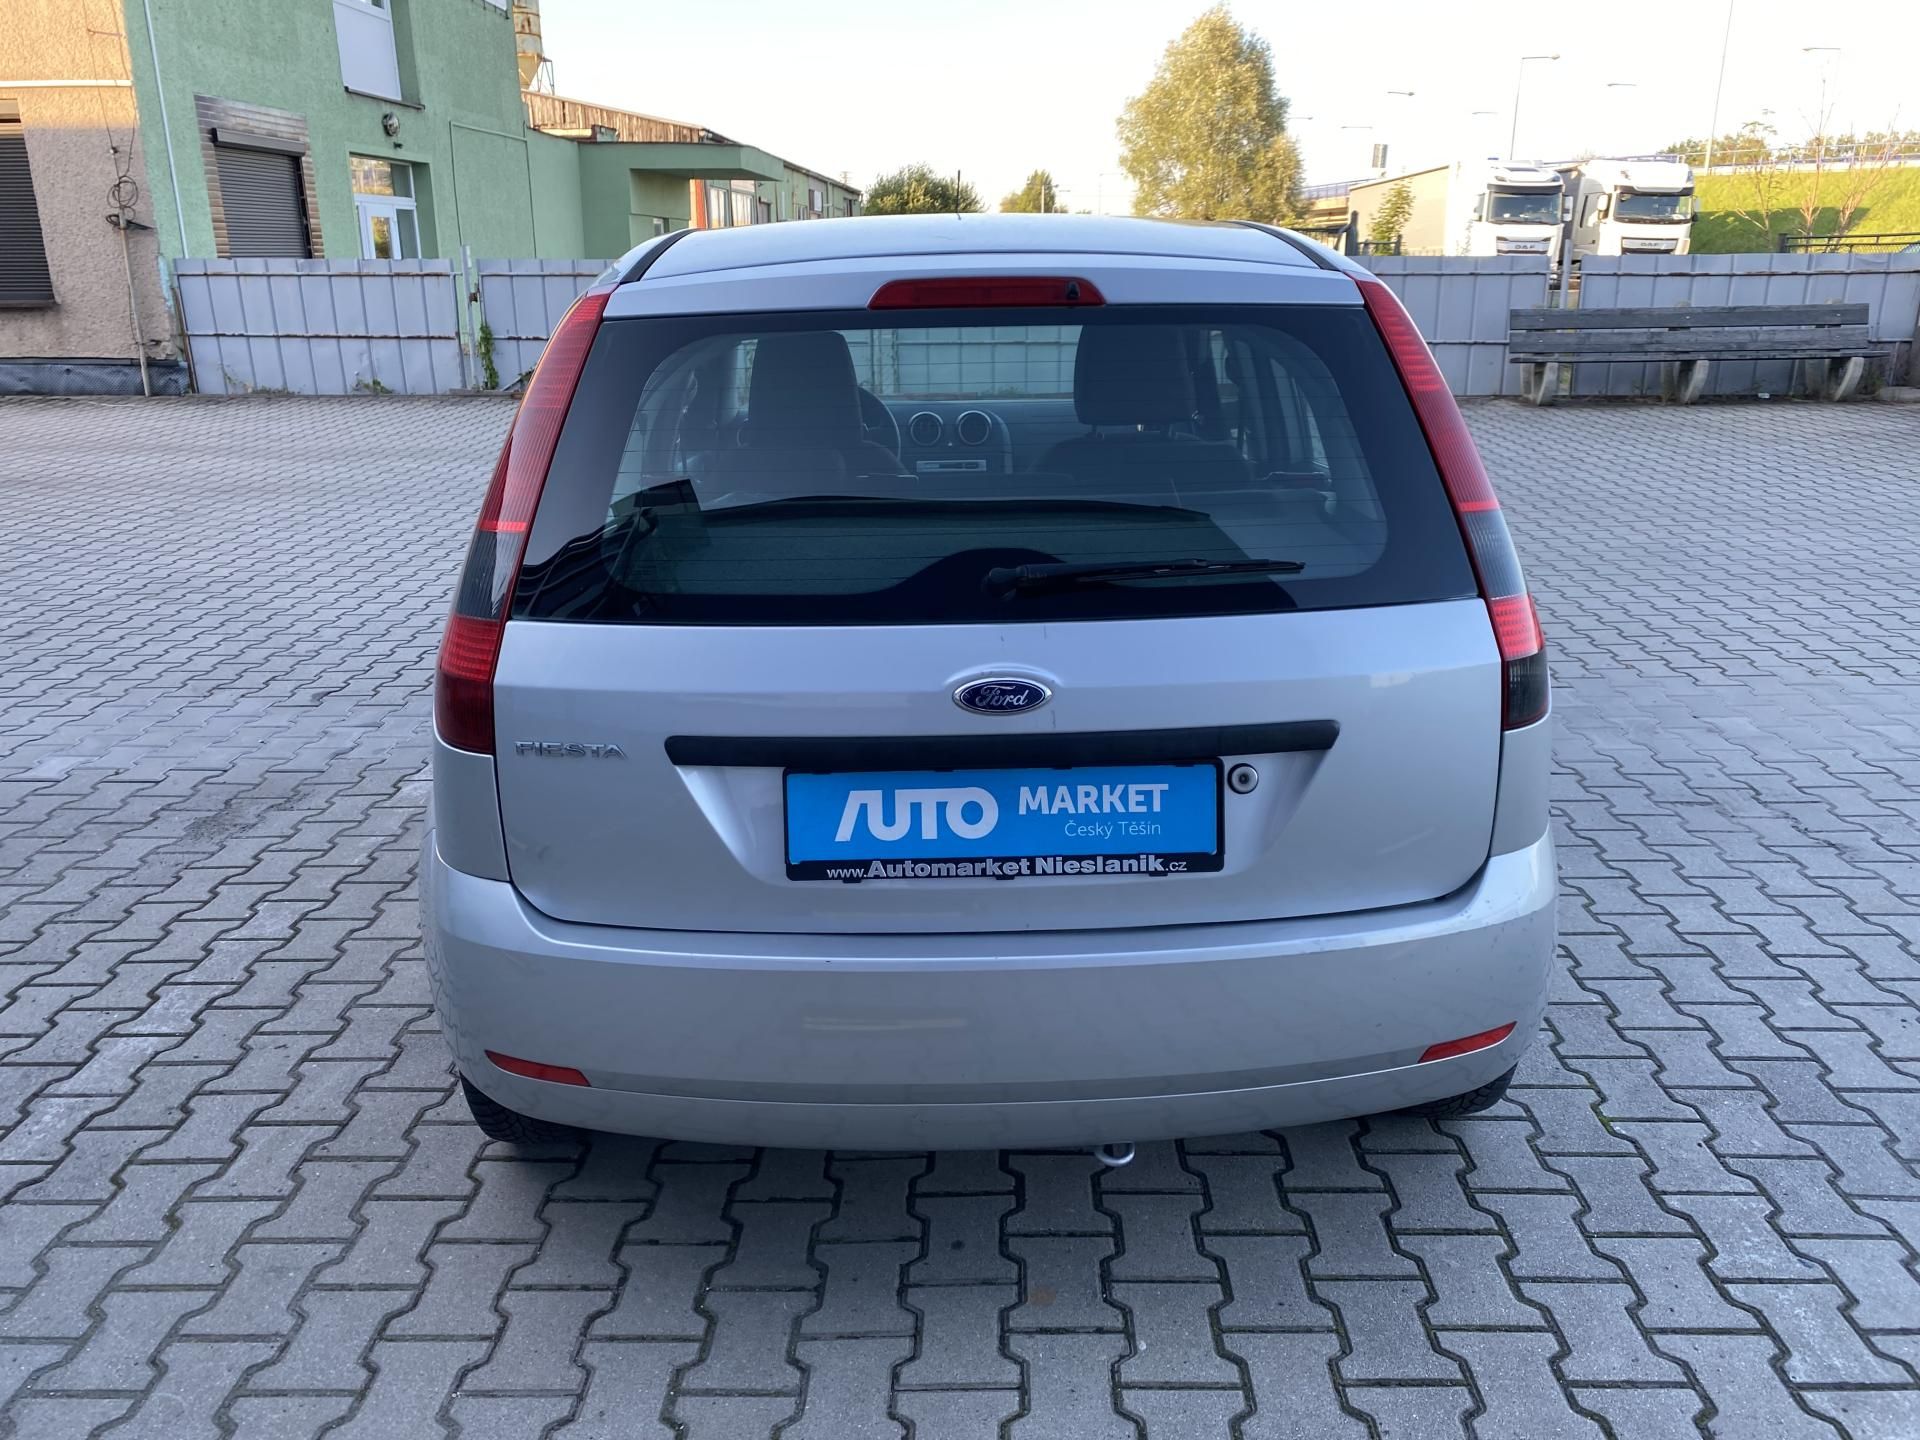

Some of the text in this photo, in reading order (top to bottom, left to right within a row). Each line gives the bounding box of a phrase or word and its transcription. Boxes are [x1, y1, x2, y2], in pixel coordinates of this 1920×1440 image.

[976, 685, 1029, 707] Ford
[515, 741, 628, 759] FIESTA
[834, 783, 1169, 842] AUTO MARKET
[1064, 819, 1161, 840] Český Těšín
